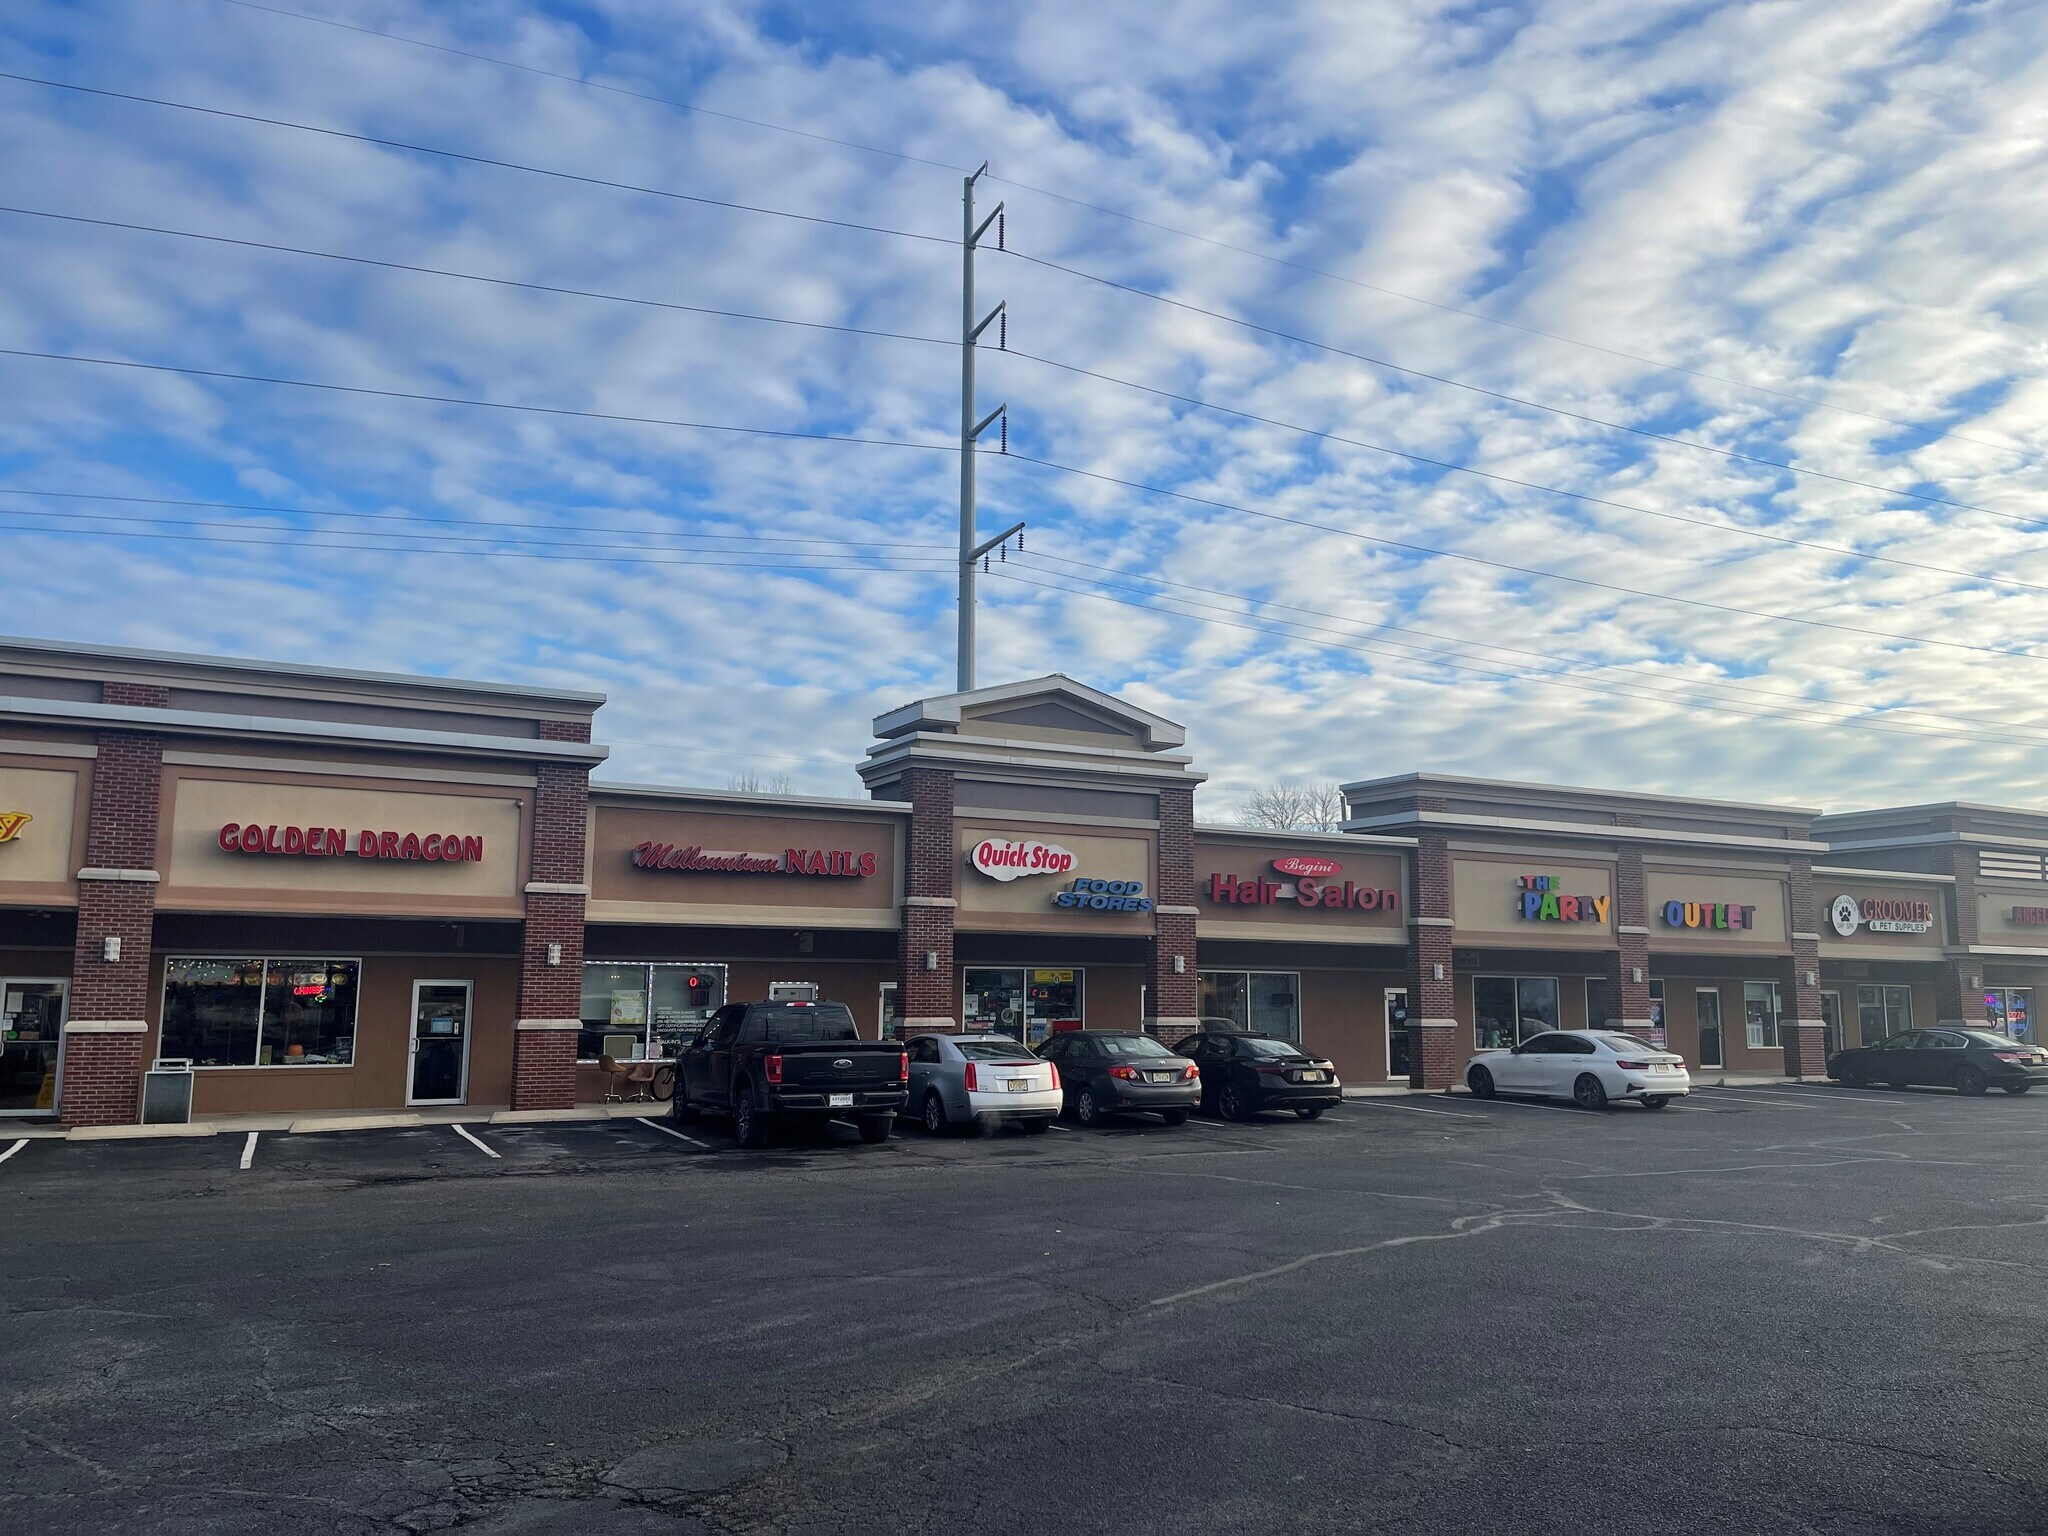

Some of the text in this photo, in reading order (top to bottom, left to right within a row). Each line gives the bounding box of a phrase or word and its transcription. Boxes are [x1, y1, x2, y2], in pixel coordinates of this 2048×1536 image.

[218, 823, 483, 861] GOLDEN DRAGON
[978, 842, 1071, 873] Quick Stop
[635, 840, 877, 877] Millennium NAILS
[1284, 857, 1334, 875] Bogini
[1057, 878, 1154, 912] FOOD STORES
[1211, 873, 1400, 913] Hair Salon
[1522, 875, 1561, 891] THE
[1521, 892, 1611, 924] PARTY
[1663, 900, 1757, 930] OUTLET
[1863, 898, 1931, 921] GROOMER
[1872, 922, 1925, 932] & PET SUPPLIES
